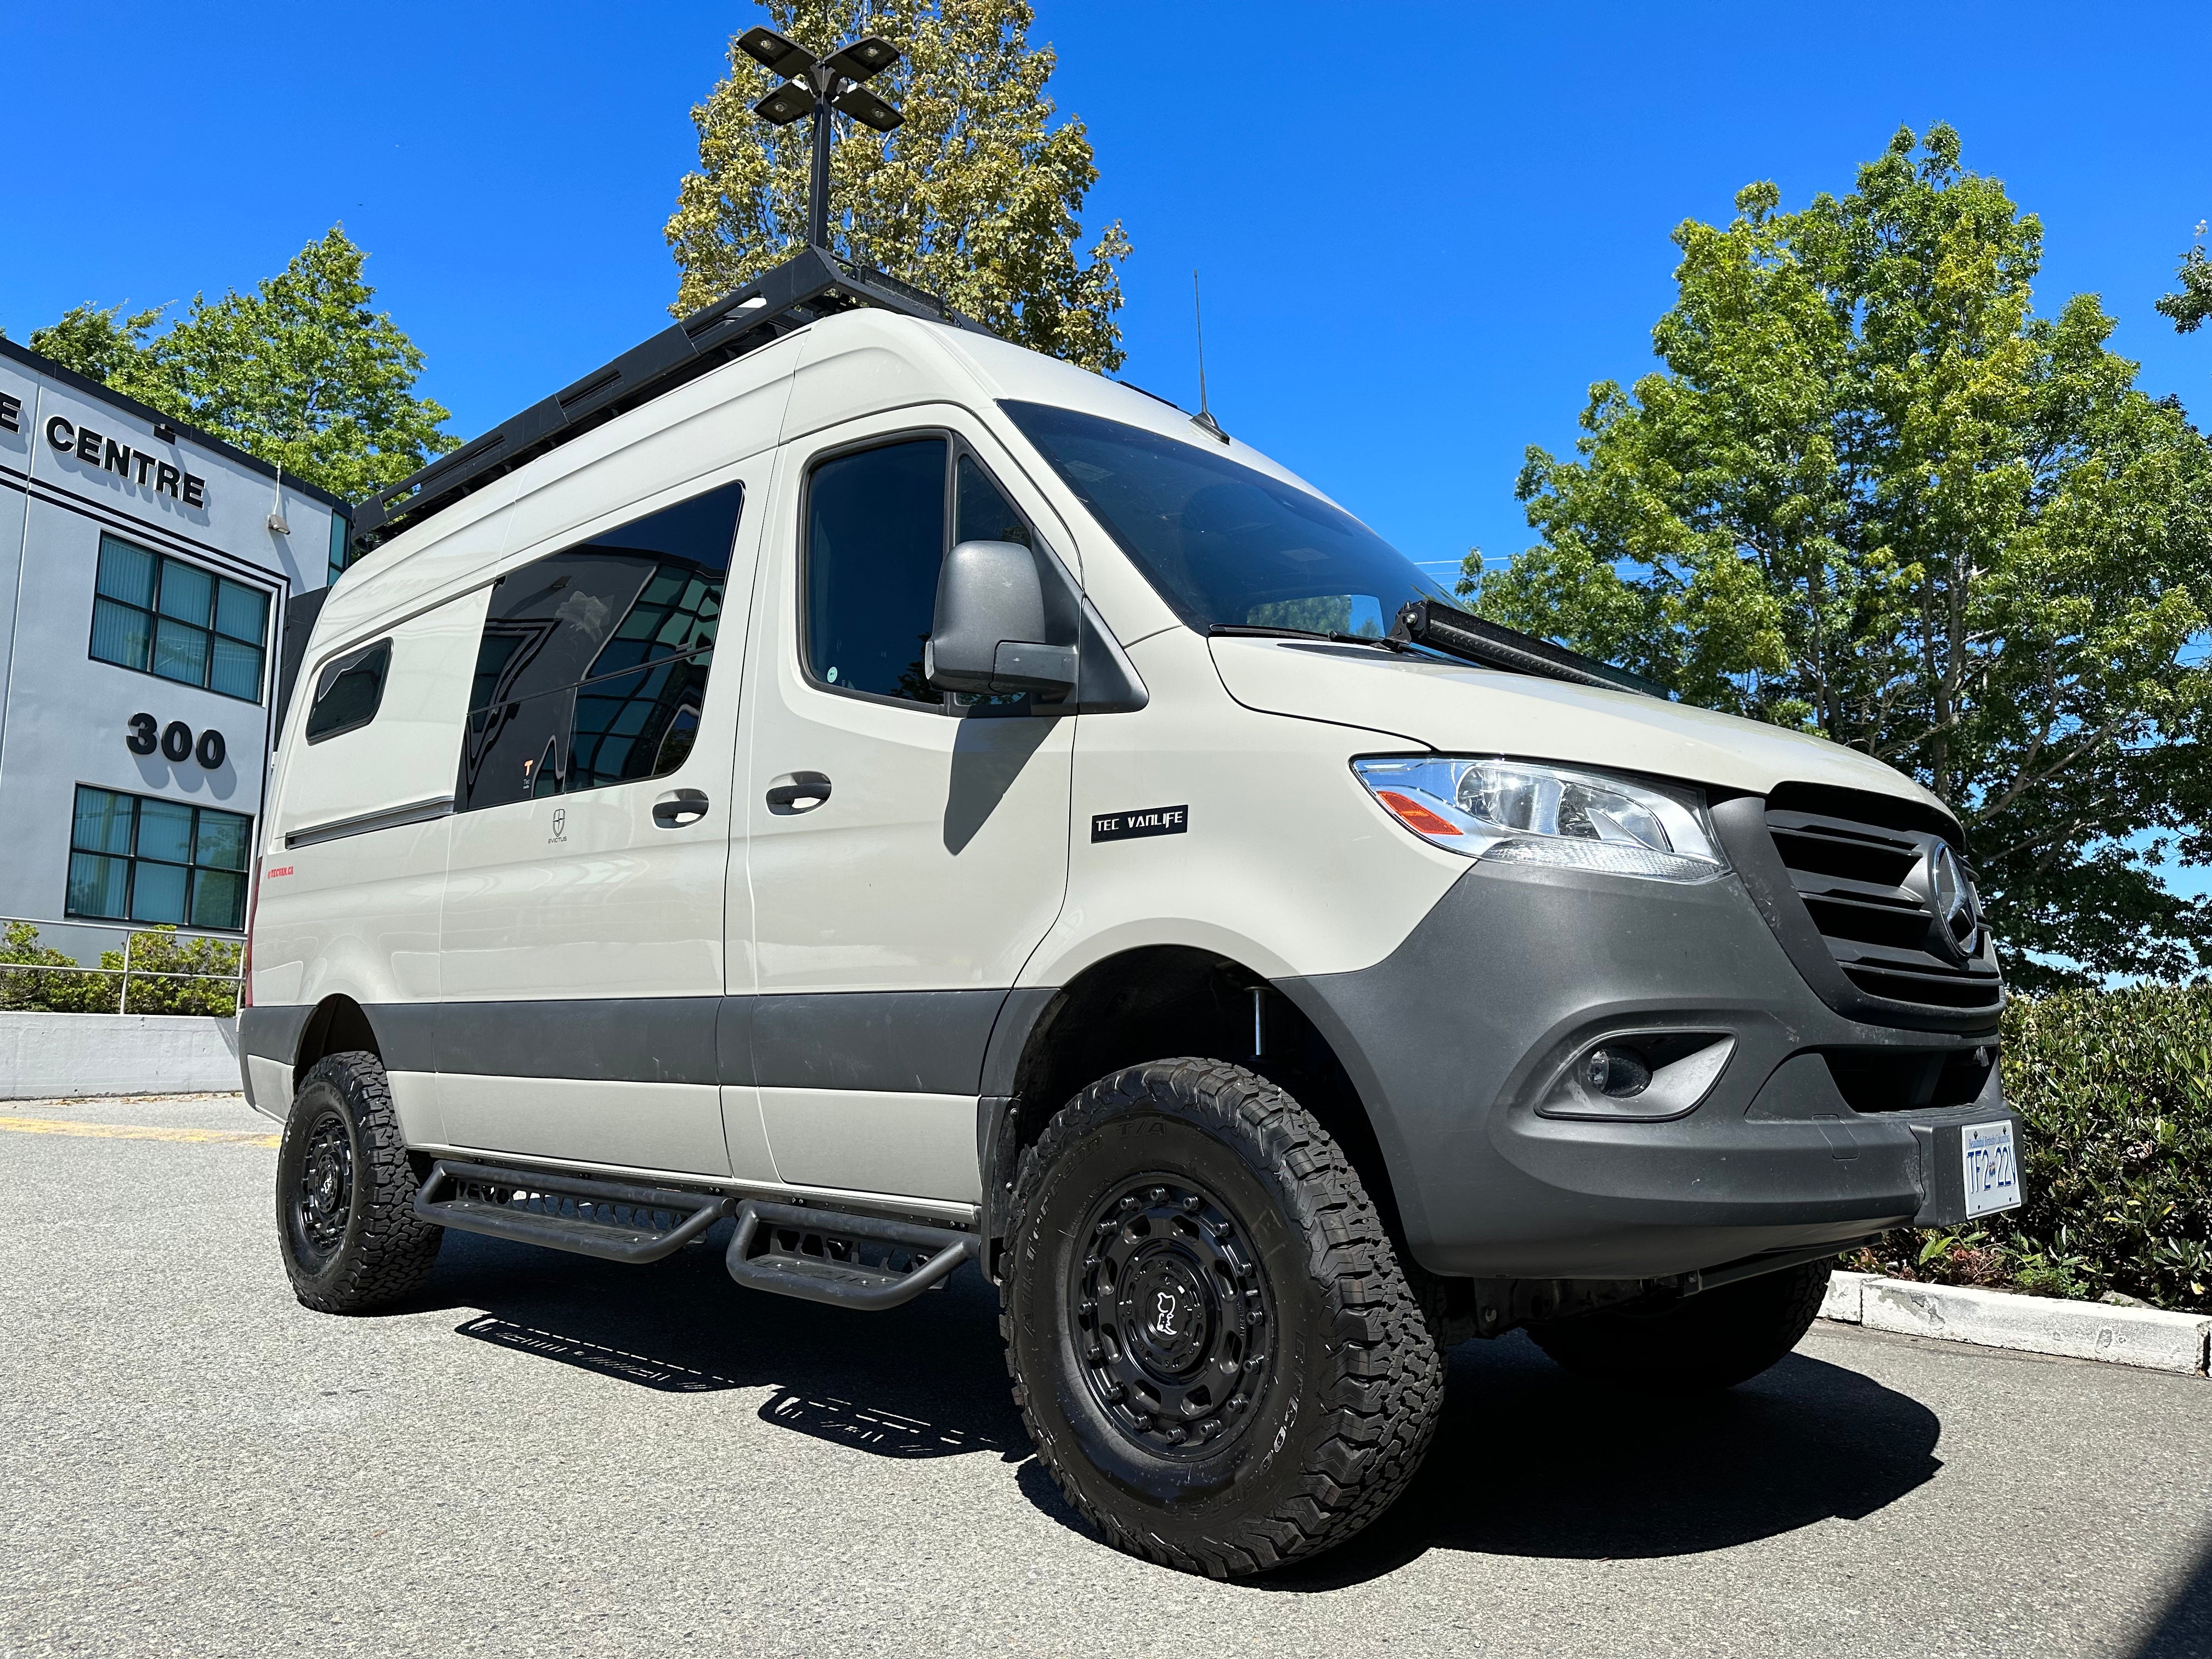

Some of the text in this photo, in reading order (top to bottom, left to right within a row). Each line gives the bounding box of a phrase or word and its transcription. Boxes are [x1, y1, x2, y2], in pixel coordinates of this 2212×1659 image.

[46, 415, 206, 510] CENTRE
[126, 713, 226, 769] 300
[1096, 811, 1183, 832] TEC VANLIFE
[1116, 1120, 1167, 1139] T/A
